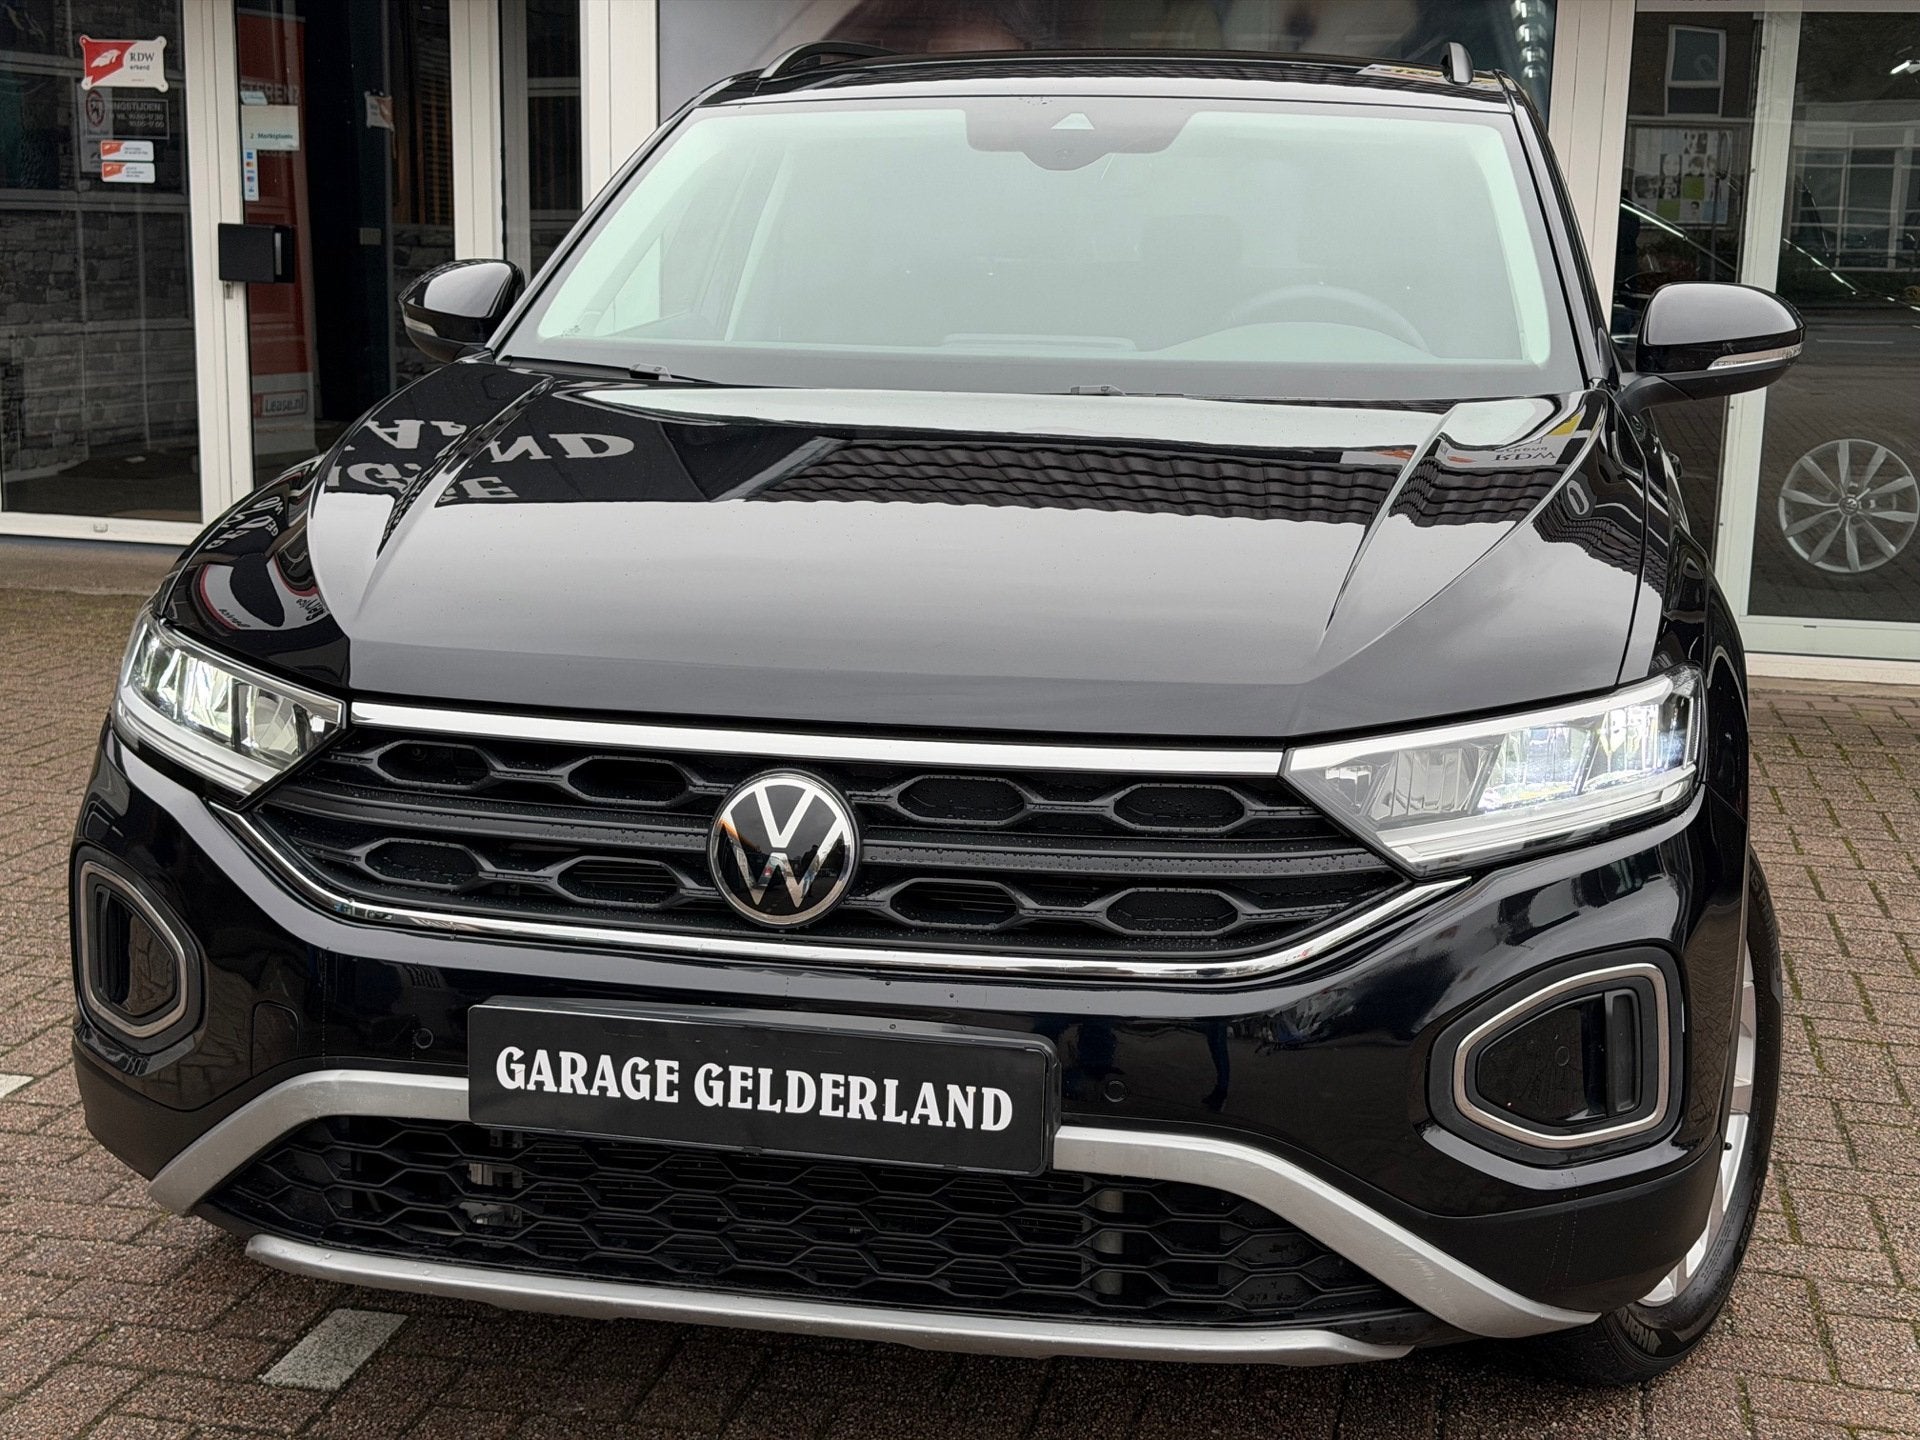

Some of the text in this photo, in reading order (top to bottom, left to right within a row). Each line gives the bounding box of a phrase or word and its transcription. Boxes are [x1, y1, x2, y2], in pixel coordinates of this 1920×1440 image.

[129, 52, 155, 62] RDW
[496, 1046, 1013, 1132] GARAGE GELDERLAND
